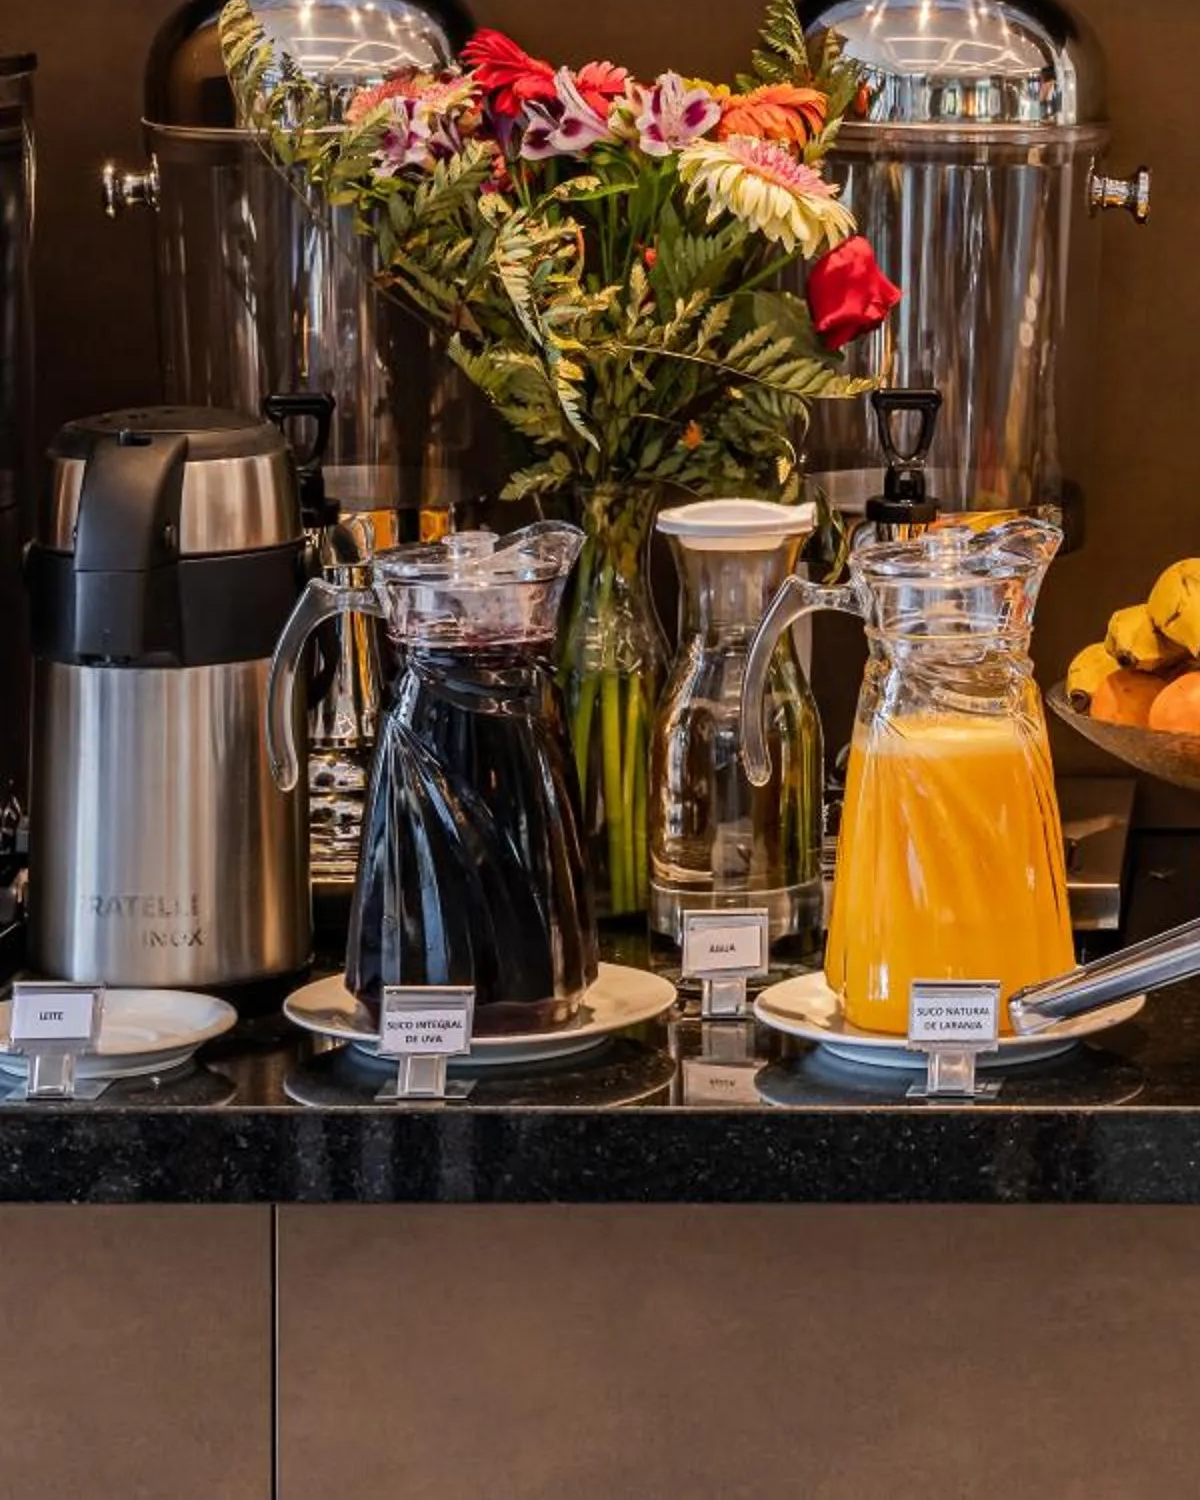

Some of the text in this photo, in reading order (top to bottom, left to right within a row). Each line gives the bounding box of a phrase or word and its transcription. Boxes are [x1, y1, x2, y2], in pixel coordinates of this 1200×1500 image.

[39, 1011, 64, 1021] LEITE
[916, 1007, 990, 1016] SUCO NATURAL
[387, 1019, 463, 1031] SUCO INTEGRAL
[923, 1021, 983, 1031] DE LARANJA
[405, 1035, 443, 1044] DE UVA
